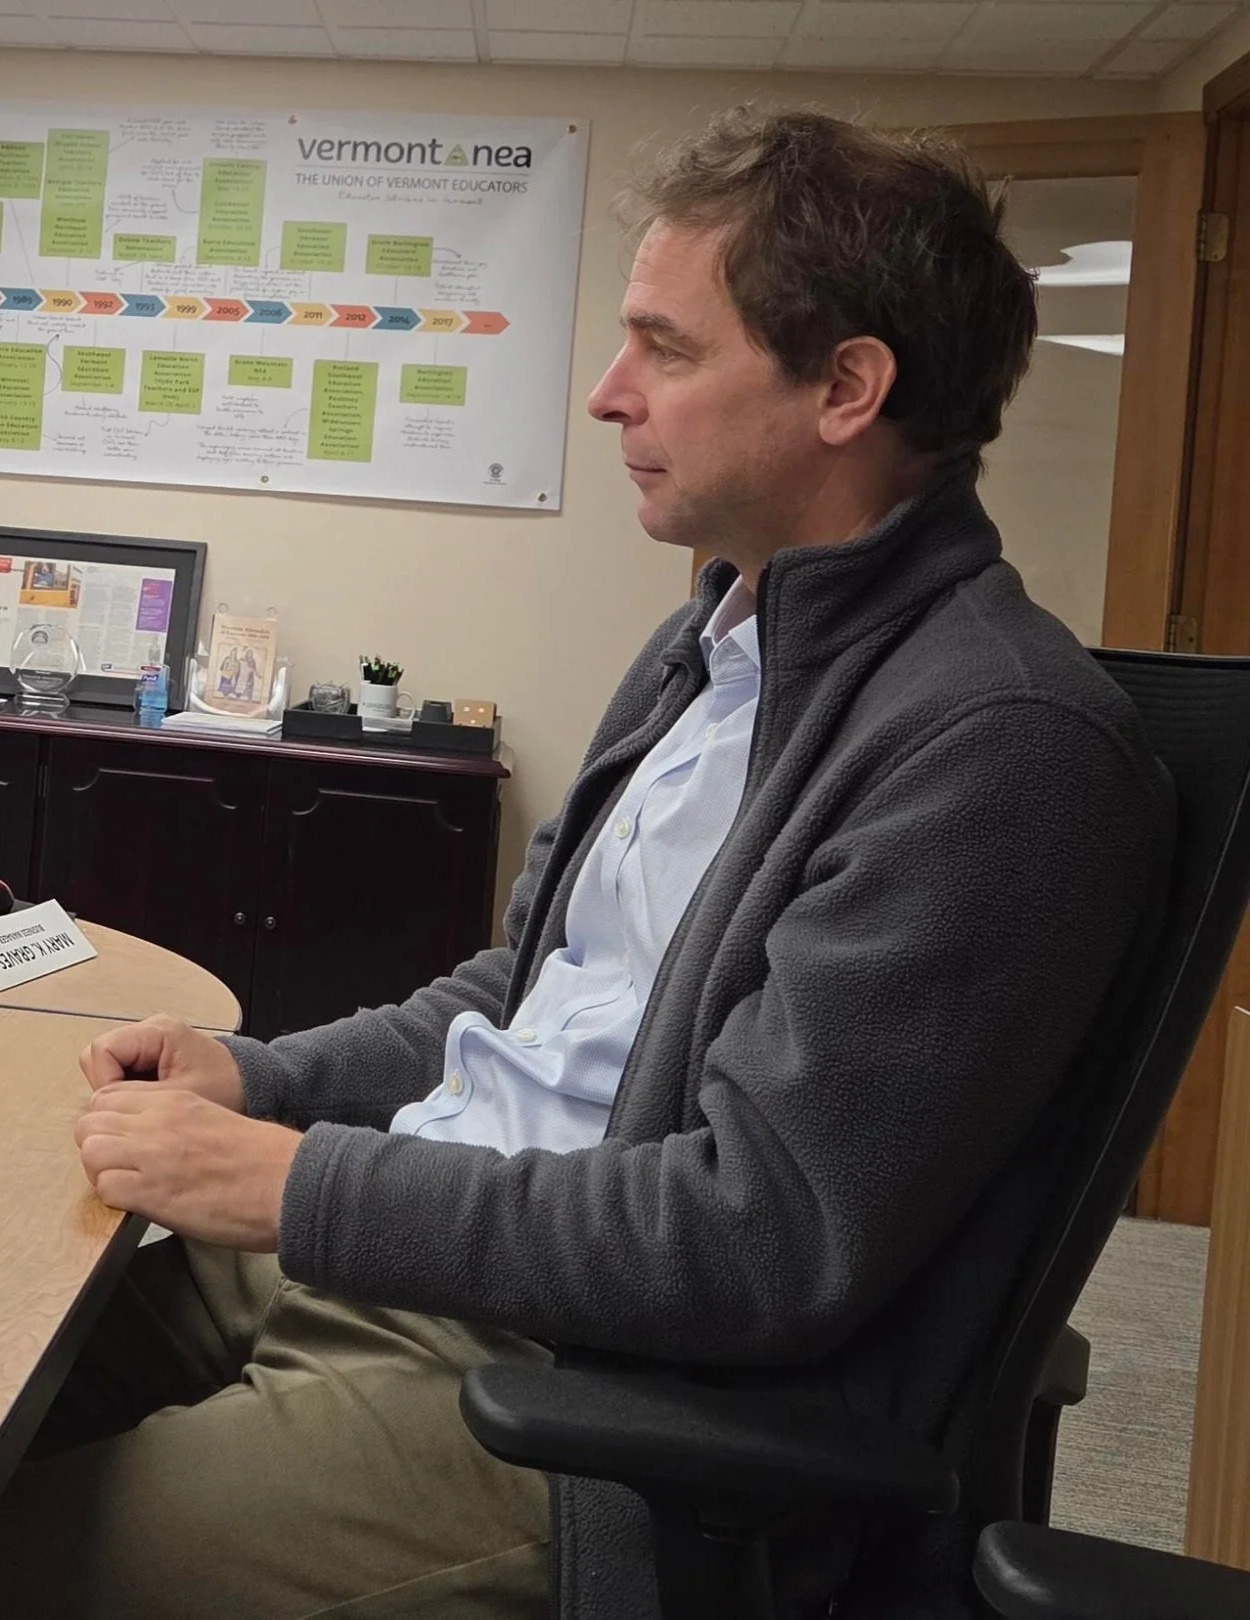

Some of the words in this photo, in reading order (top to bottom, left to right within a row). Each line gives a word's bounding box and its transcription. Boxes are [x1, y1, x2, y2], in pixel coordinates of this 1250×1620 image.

[297, 137, 443, 166] vermont
[472, 144, 531, 169] nea
[295, 172, 318, 186] THE
[321, 174, 364, 188] UNION
[365, 176, 383, 189] OF
[385, 177, 450, 191] VERMONT
[452, 179, 529, 194] EDUCATORS
[52, 297, 73, 307] 1990
[176, 304, 198, 314] 1999
[216, 305, 240, 316] 2005
[302, 310, 323, 320] 2011
[42, 930, 76, 954] MARY
[30, 941, 49, 957] K.
